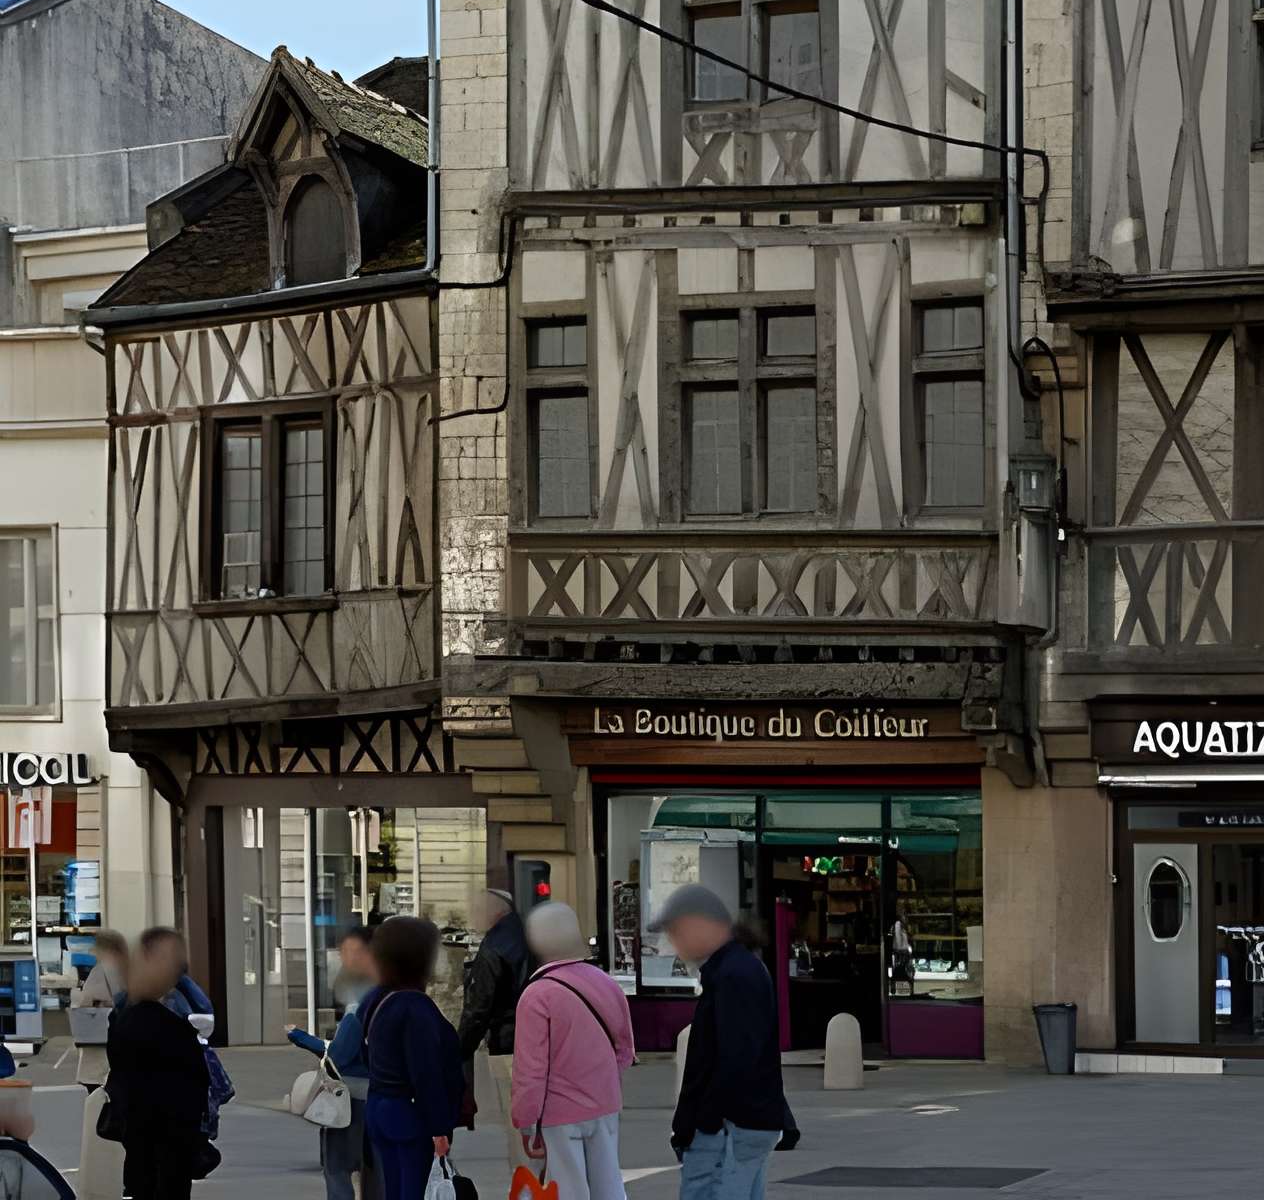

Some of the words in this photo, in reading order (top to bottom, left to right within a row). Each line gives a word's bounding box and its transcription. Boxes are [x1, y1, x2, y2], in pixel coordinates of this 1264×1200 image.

[593, 706, 625, 735] La
[635, 707, 757, 744] Boutique
[767, 707, 801, 738] du
